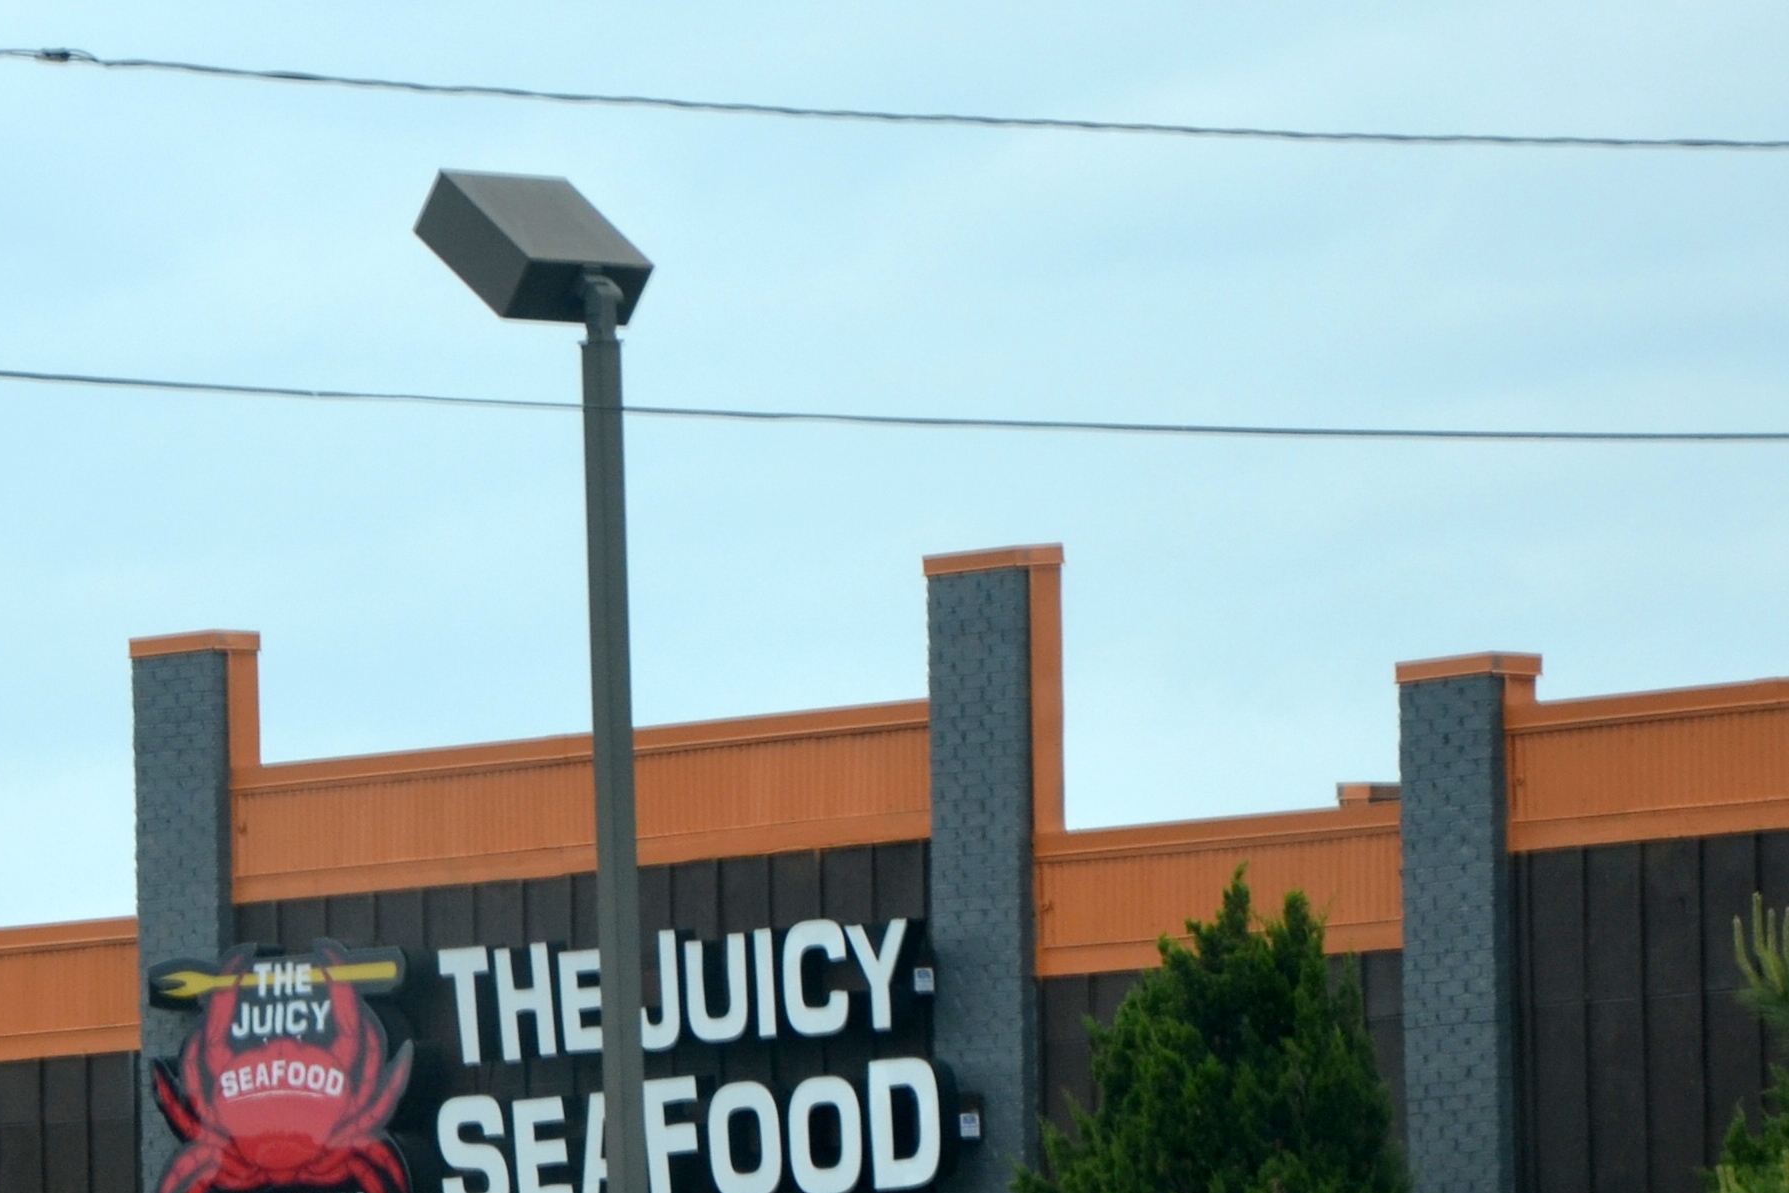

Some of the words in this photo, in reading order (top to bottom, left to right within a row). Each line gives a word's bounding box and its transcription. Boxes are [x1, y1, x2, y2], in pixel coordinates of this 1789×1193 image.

[253, 962, 312, 998] THE
[438, 942, 604, 1066] THE
[640, 918, 908, 1052] JUICY
[232, 1000, 332, 1038] JUICY
[220, 1059, 345, 1098] SEAFOOD
